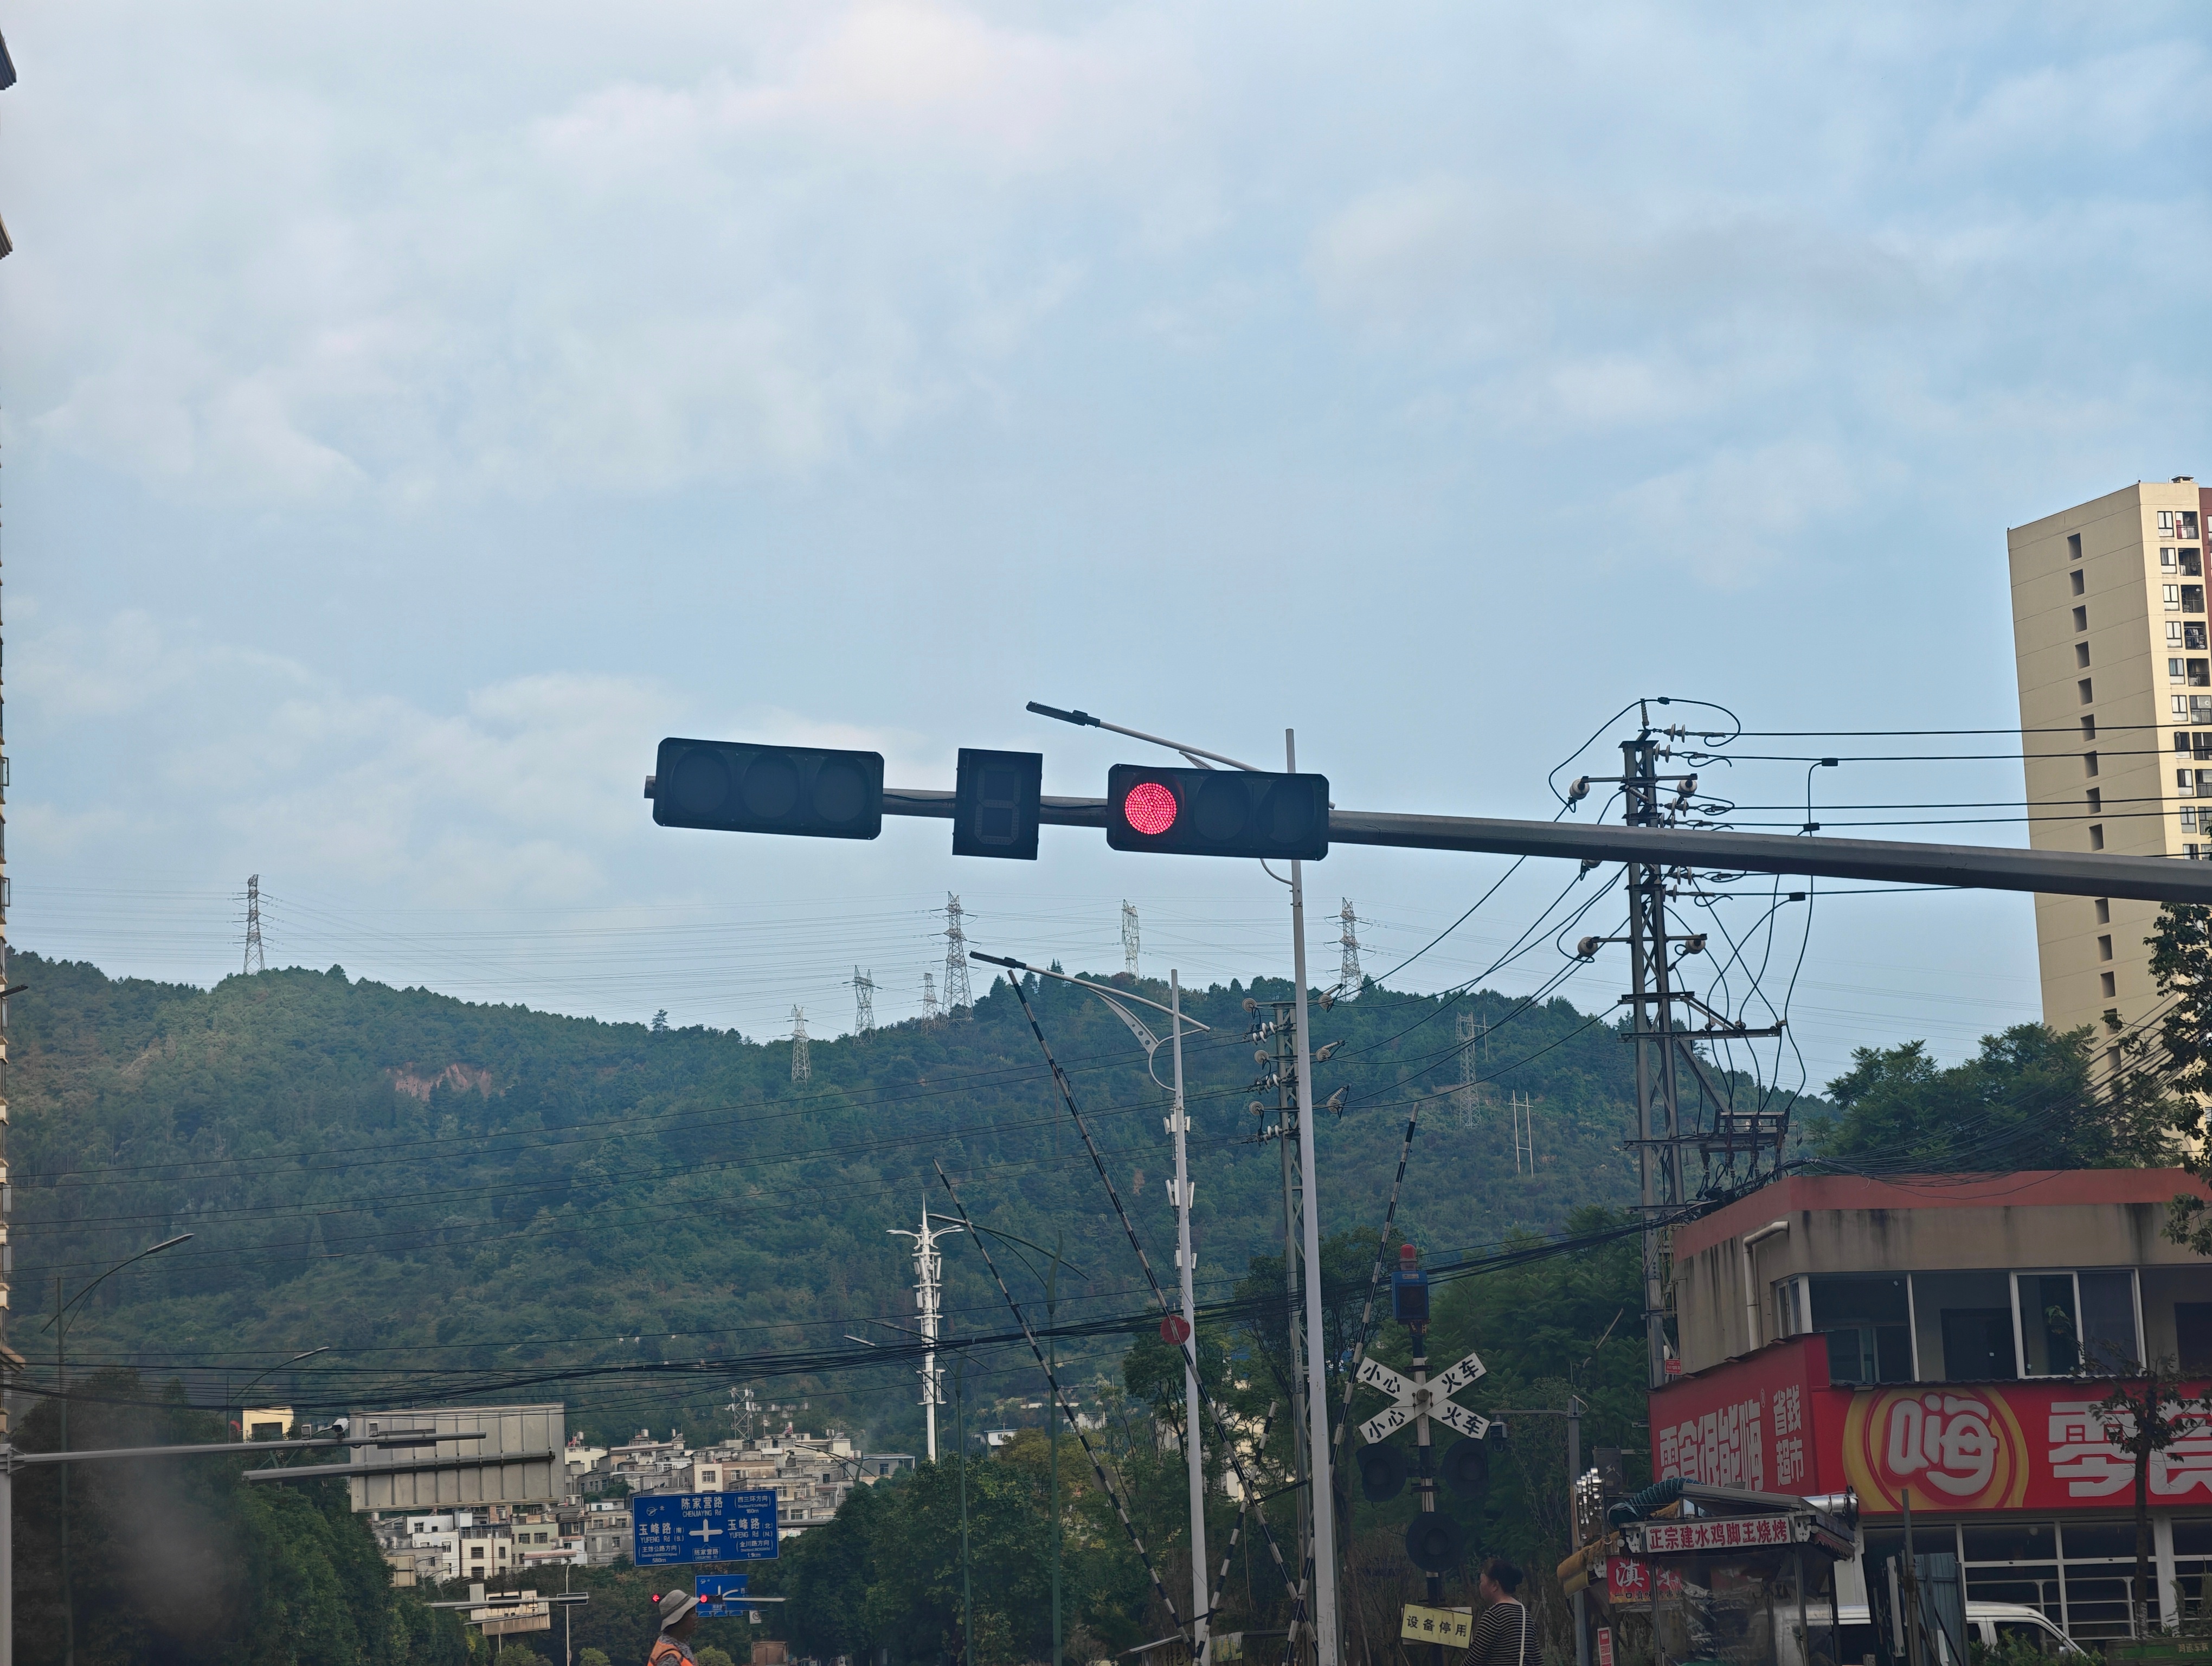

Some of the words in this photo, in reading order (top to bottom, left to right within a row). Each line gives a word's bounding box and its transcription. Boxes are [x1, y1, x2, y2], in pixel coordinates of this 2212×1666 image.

[1362, 1363, 1401, 1394] 小心
[1442, 1405, 1484, 1436] 火车
[1368, 1408, 1406, 1439] 小心
[1441, 1359, 1480, 1393] 火车
[1773, 1384, 1802, 1437] 省钱
[1776, 1436, 1804, 1486] 超市
[681, 1496, 723, 1510] 陈家营路
[638, 1522, 671, 1536] 玉峰路
[727, 1517, 760, 1531] 玉峰路
[1650, 1518, 1788, 1550] 正宗建水鸡脚王烧烤
[1406, 1615, 1468, 1637] 设备停用
